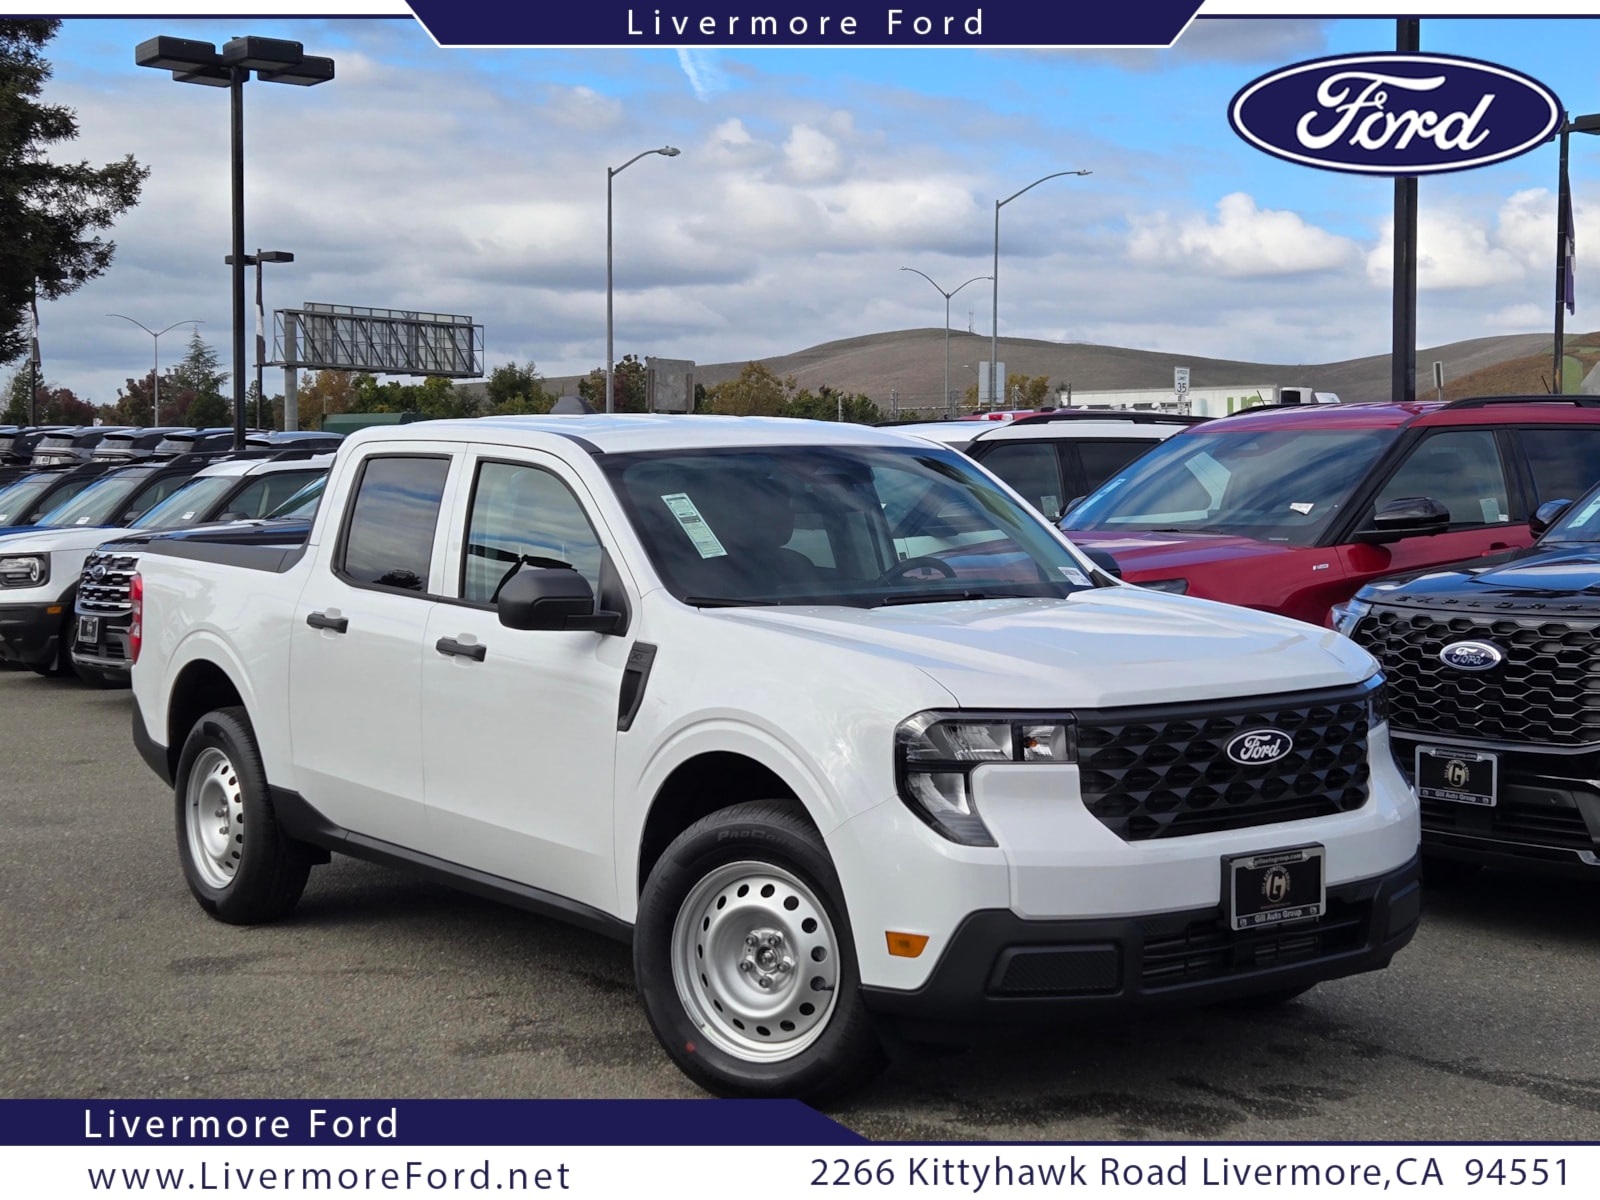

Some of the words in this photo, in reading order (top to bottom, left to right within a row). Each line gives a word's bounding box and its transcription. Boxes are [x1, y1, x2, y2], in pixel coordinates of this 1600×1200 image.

[1177, 382, 1187, 393] 35
[1395, 596, 1600, 613] EXPLORE
[1451, 647, 1485, 665] Ford
[1240, 735, 1281, 760] Ford
[1446, 791, 1459, 800] Auto
[1459, 794, 1477, 802] Group
[1254, 913, 1266, 923] Gill
[1267, 911, 1281, 921] Auto
[1282, 909, 1302, 919] Group
